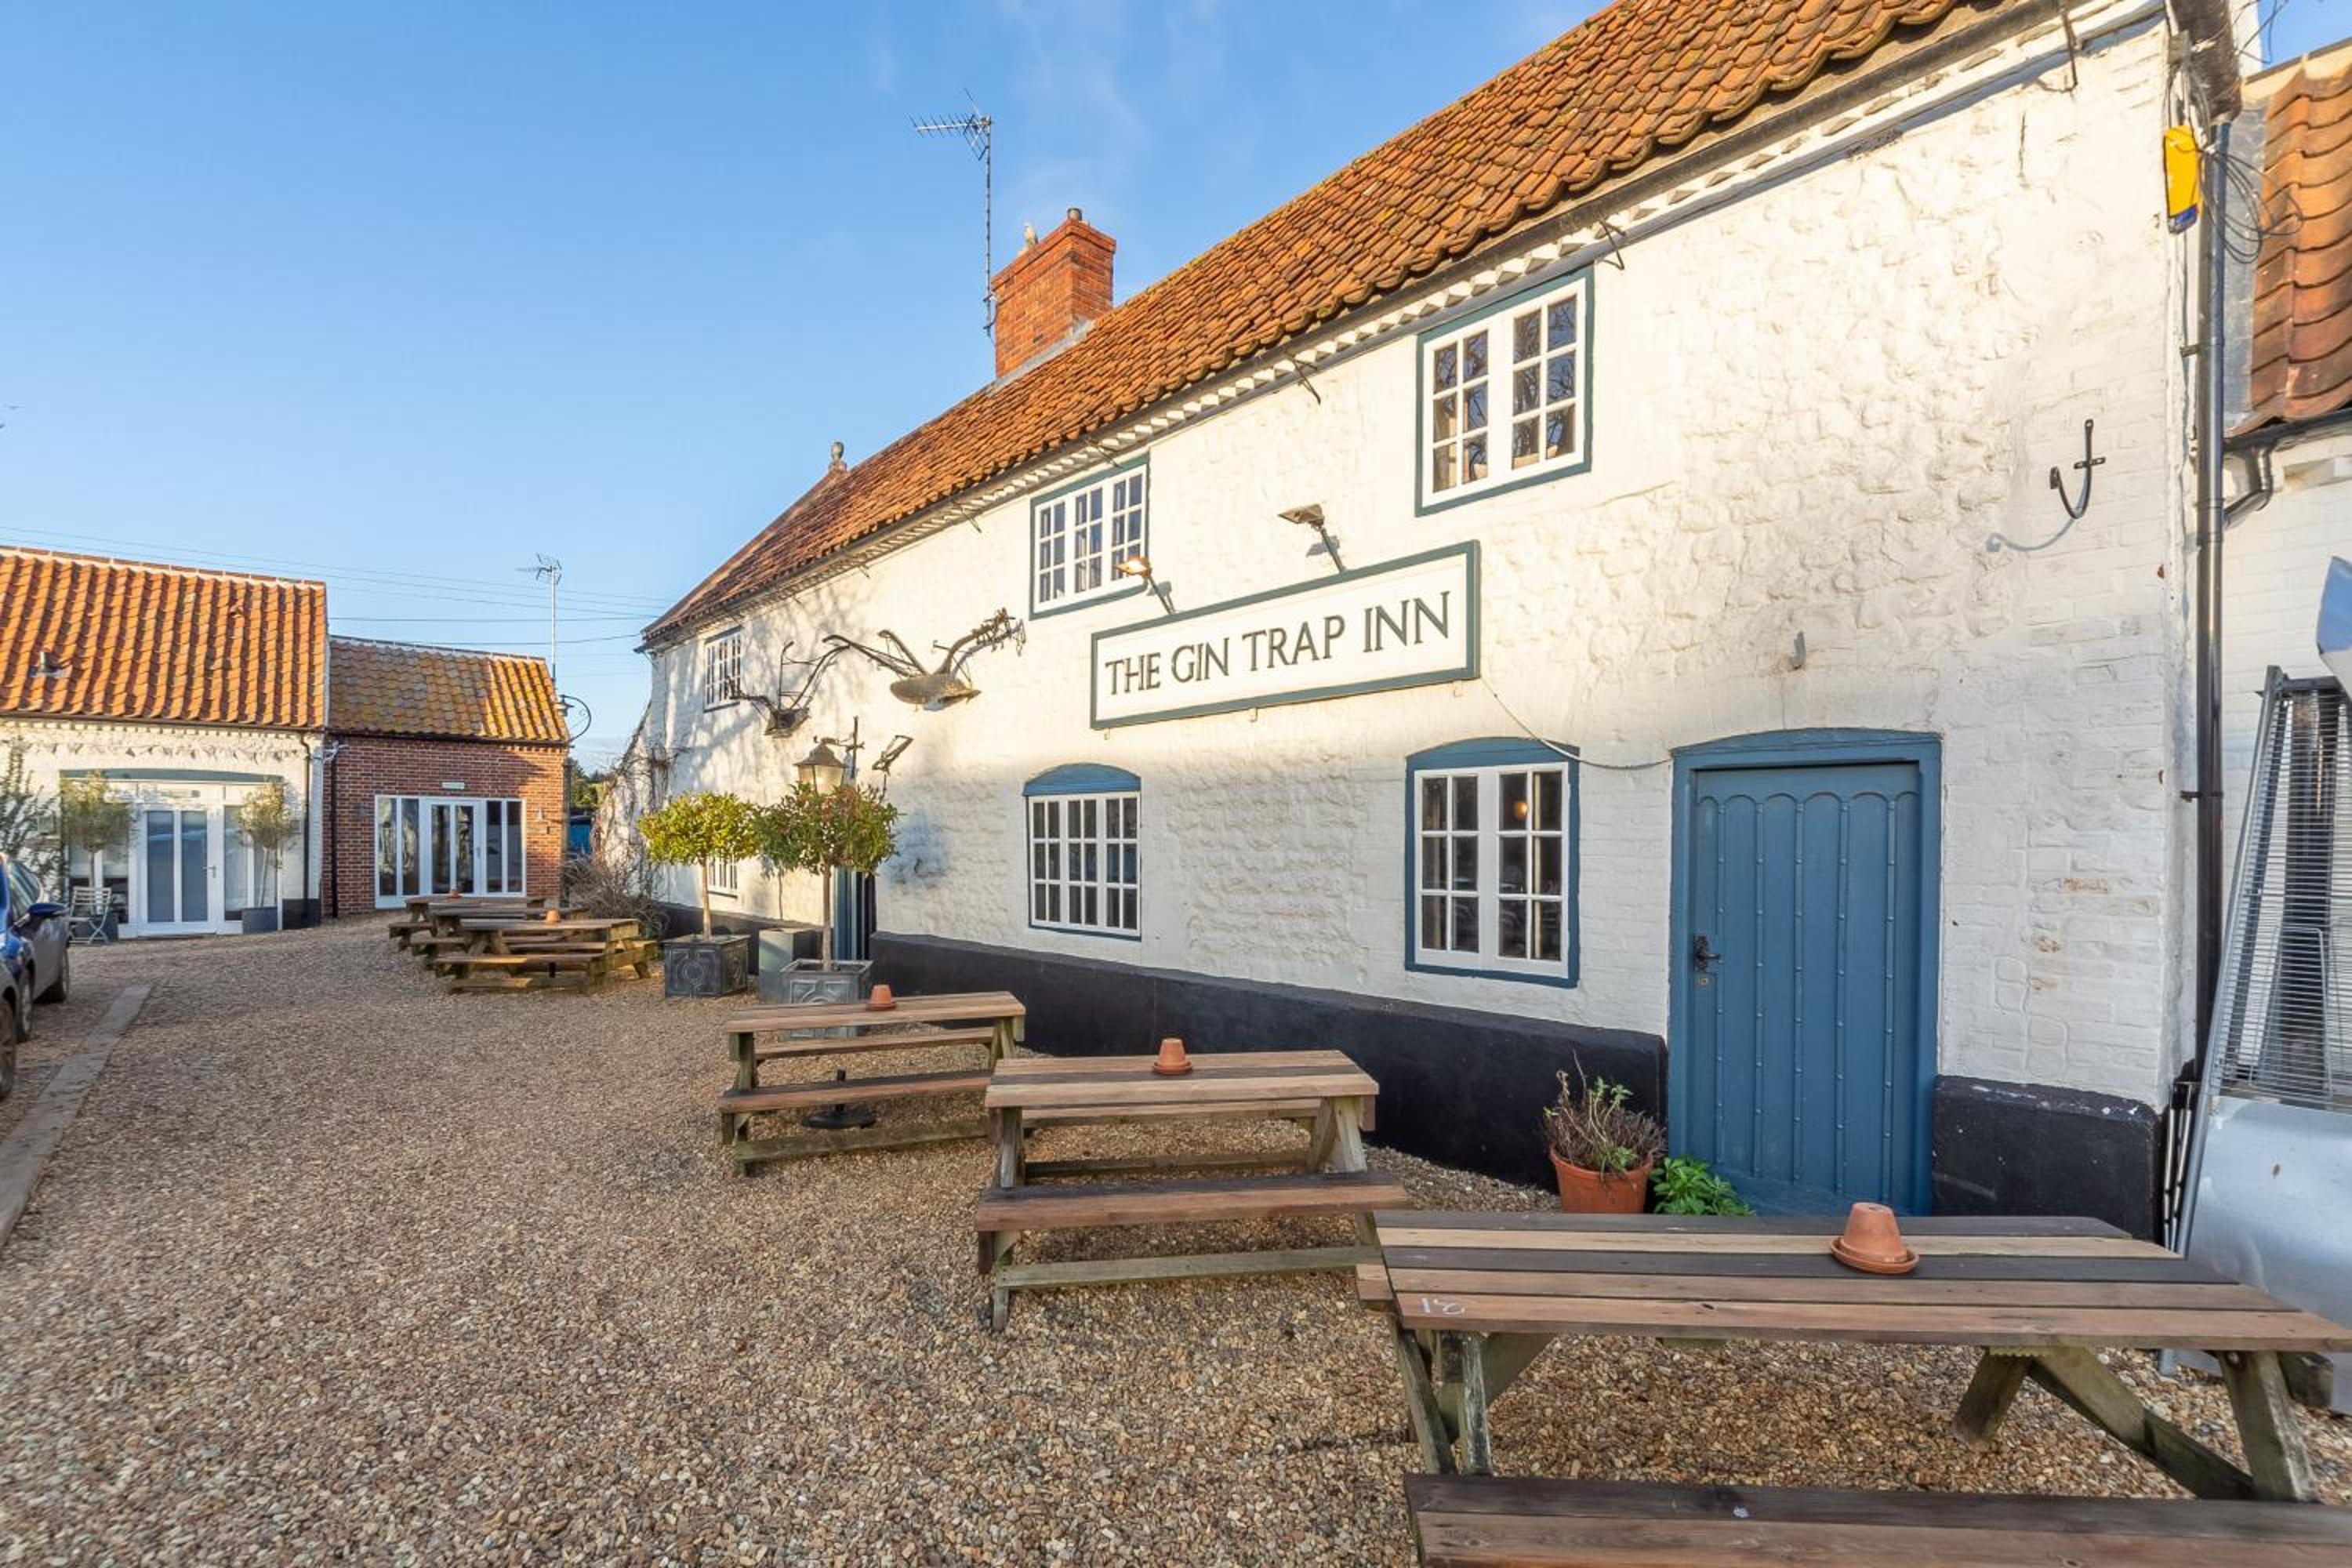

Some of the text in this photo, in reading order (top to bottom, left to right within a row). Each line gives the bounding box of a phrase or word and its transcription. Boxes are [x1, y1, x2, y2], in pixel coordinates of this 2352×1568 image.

[1105, 590, 1450, 695] THE GIN TRAP INN
